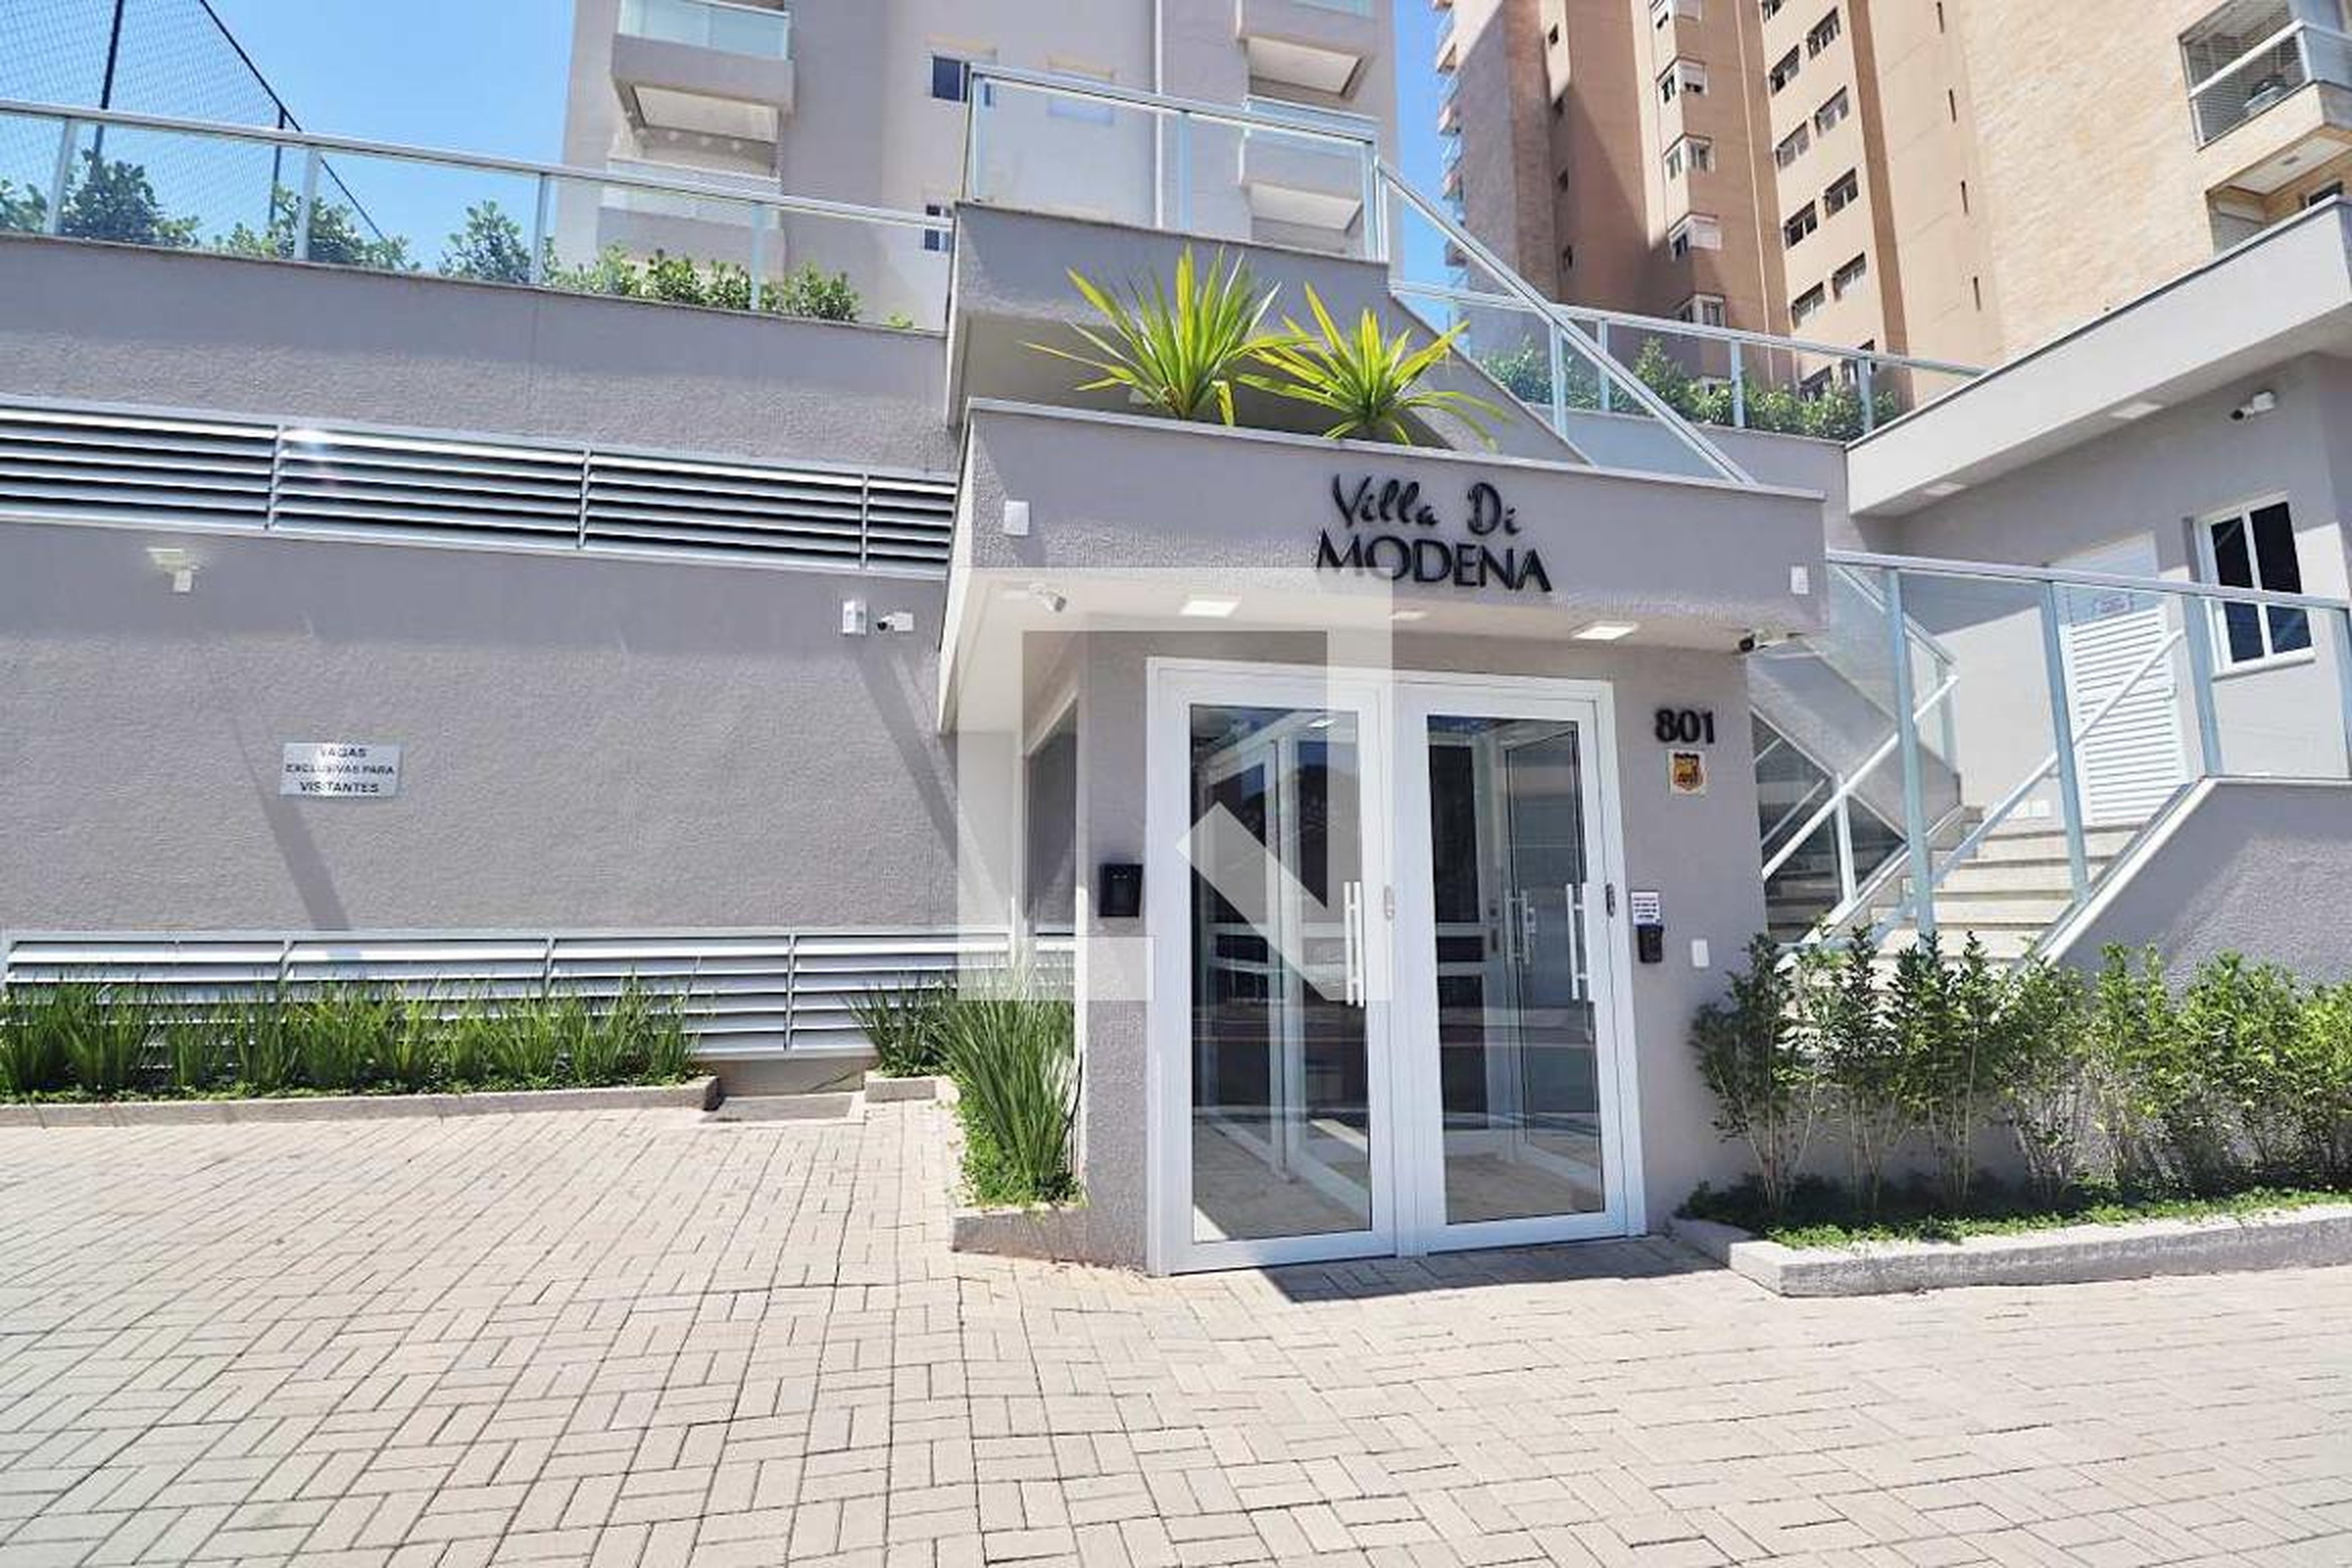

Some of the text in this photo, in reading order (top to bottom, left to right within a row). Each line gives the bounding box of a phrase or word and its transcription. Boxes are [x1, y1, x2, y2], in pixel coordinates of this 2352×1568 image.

[1333, 473, 1521, 536] Villa Di
[1316, 529, 1552, 592] MODENA
[1656, 709, 1714, 744] 801
[320, 747, 366, 758] VAGAS
[363, 765, 394, 775] PARA
[299, 781, 379, 793] VISTANTES
